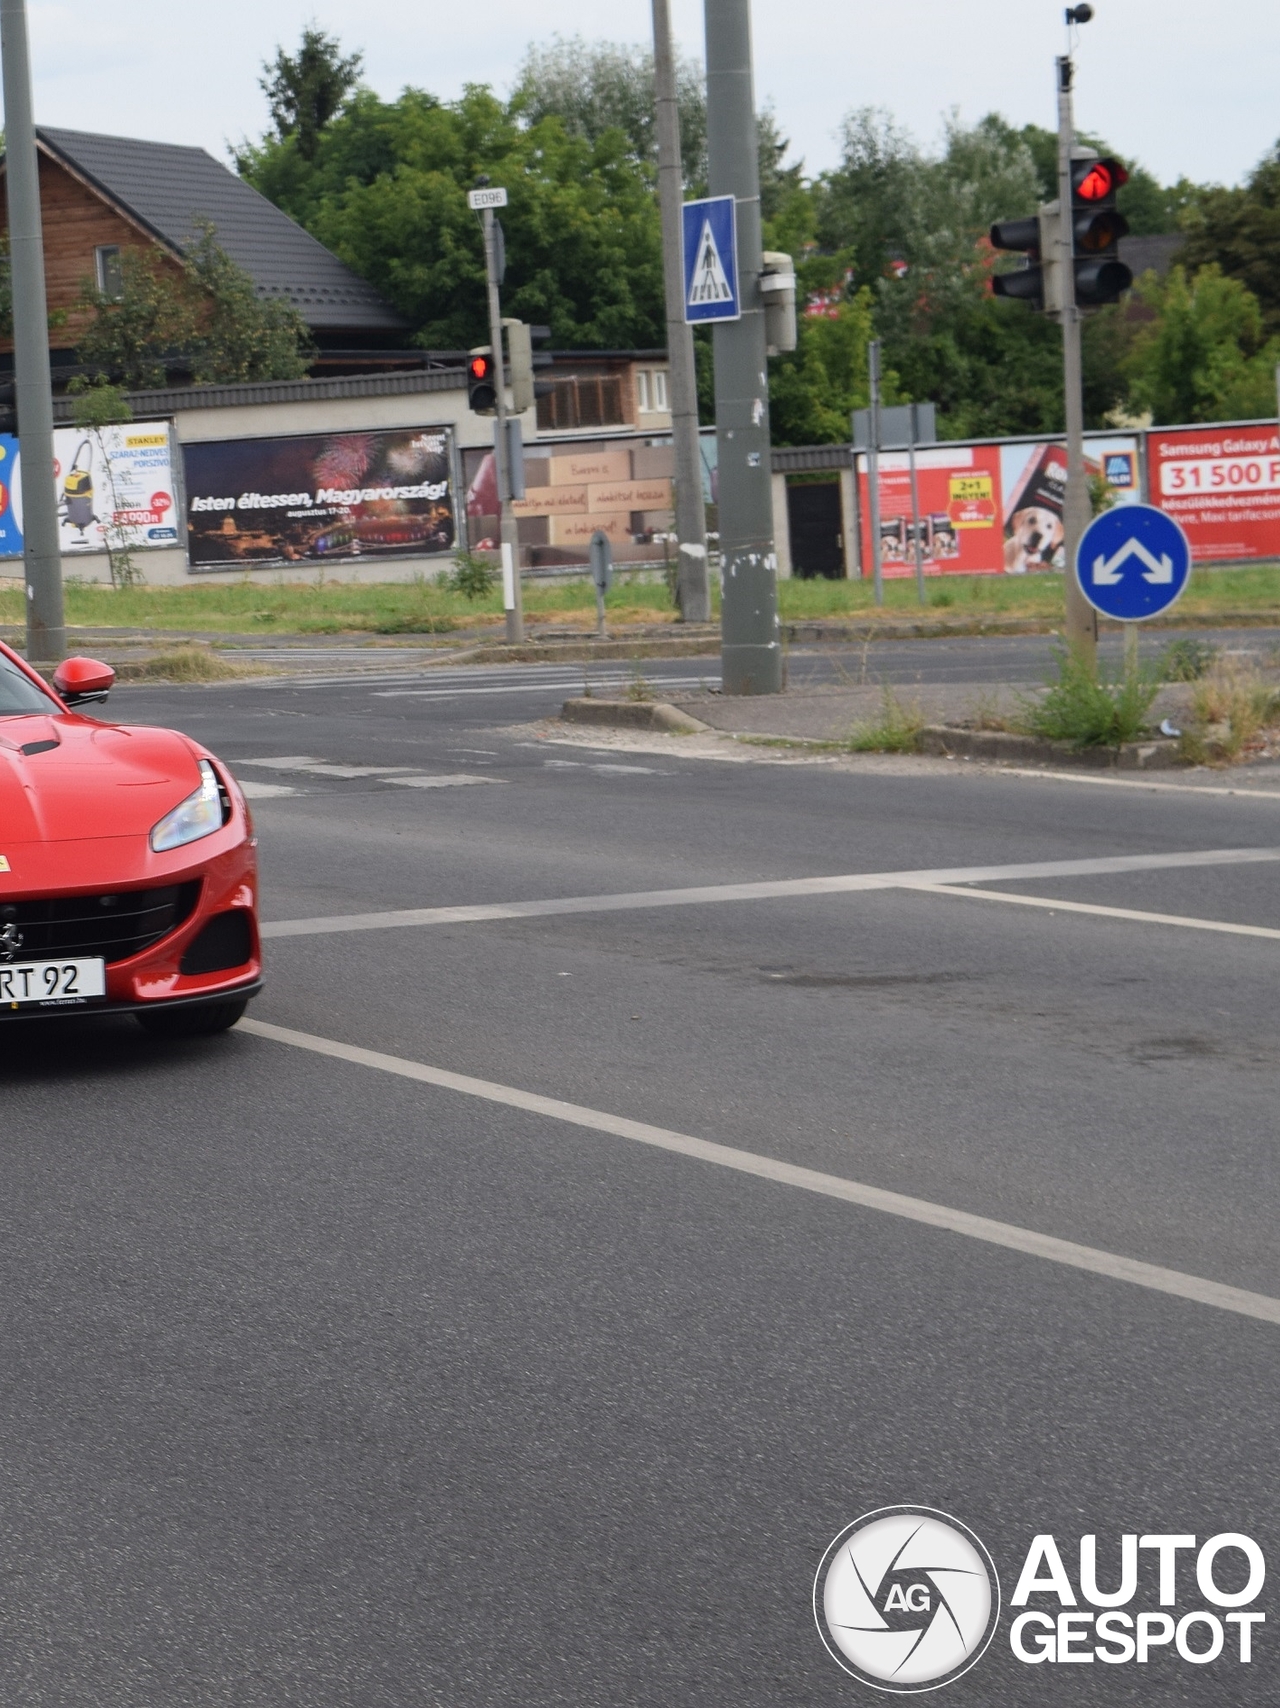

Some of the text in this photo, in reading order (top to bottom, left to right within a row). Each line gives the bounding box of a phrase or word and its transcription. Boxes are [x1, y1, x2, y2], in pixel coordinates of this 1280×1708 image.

[473, 191, 503, 205] E096
[127, 436, 165, 446] STANLEY
[1159, 443, 1221, 457] Samsung
[1223, 438, 1267, 453] Galaxy
[1108, 474, 1131, 484] ALDI
[1171, 467, 1200, 488] 31
[1211, 463, 1261, 486] 500
[960, 481, 981, 491] 2+1
[191, 481, 447, 511] Isten éltessen, Magyarország!
[952, 492, 989, 501] INGYEN!
[286, 507, 326, 517] augusztus
[1201, 511, 1225, 522] Maxi
[43, 965, 78, 996] 92
